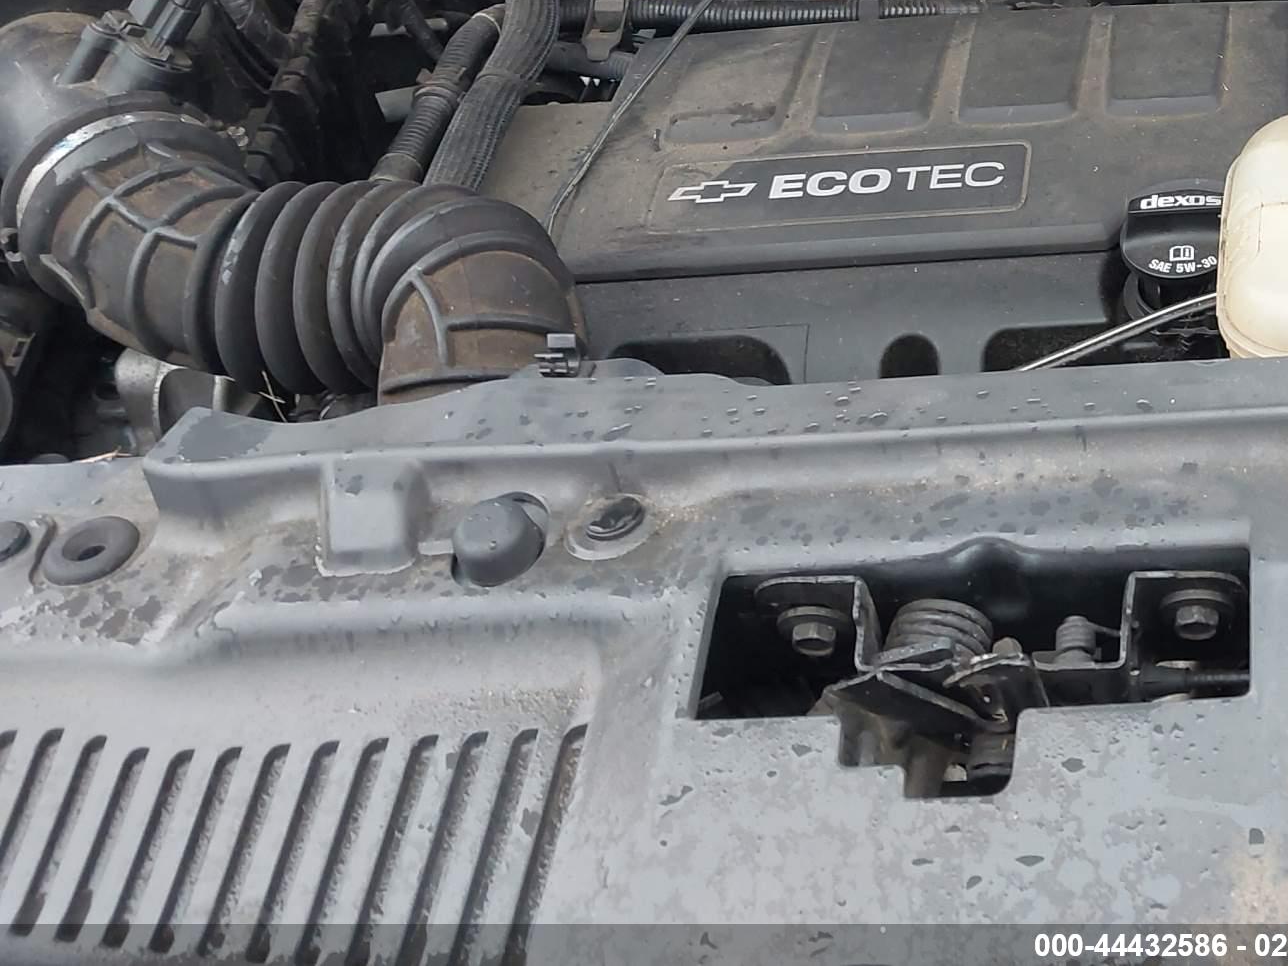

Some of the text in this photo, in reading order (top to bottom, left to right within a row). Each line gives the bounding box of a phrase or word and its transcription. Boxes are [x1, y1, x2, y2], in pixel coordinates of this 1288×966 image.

[768, 161, 1005, 200] ECOTEC
[1148, 255, 1218, 273] SAE 5W-30
